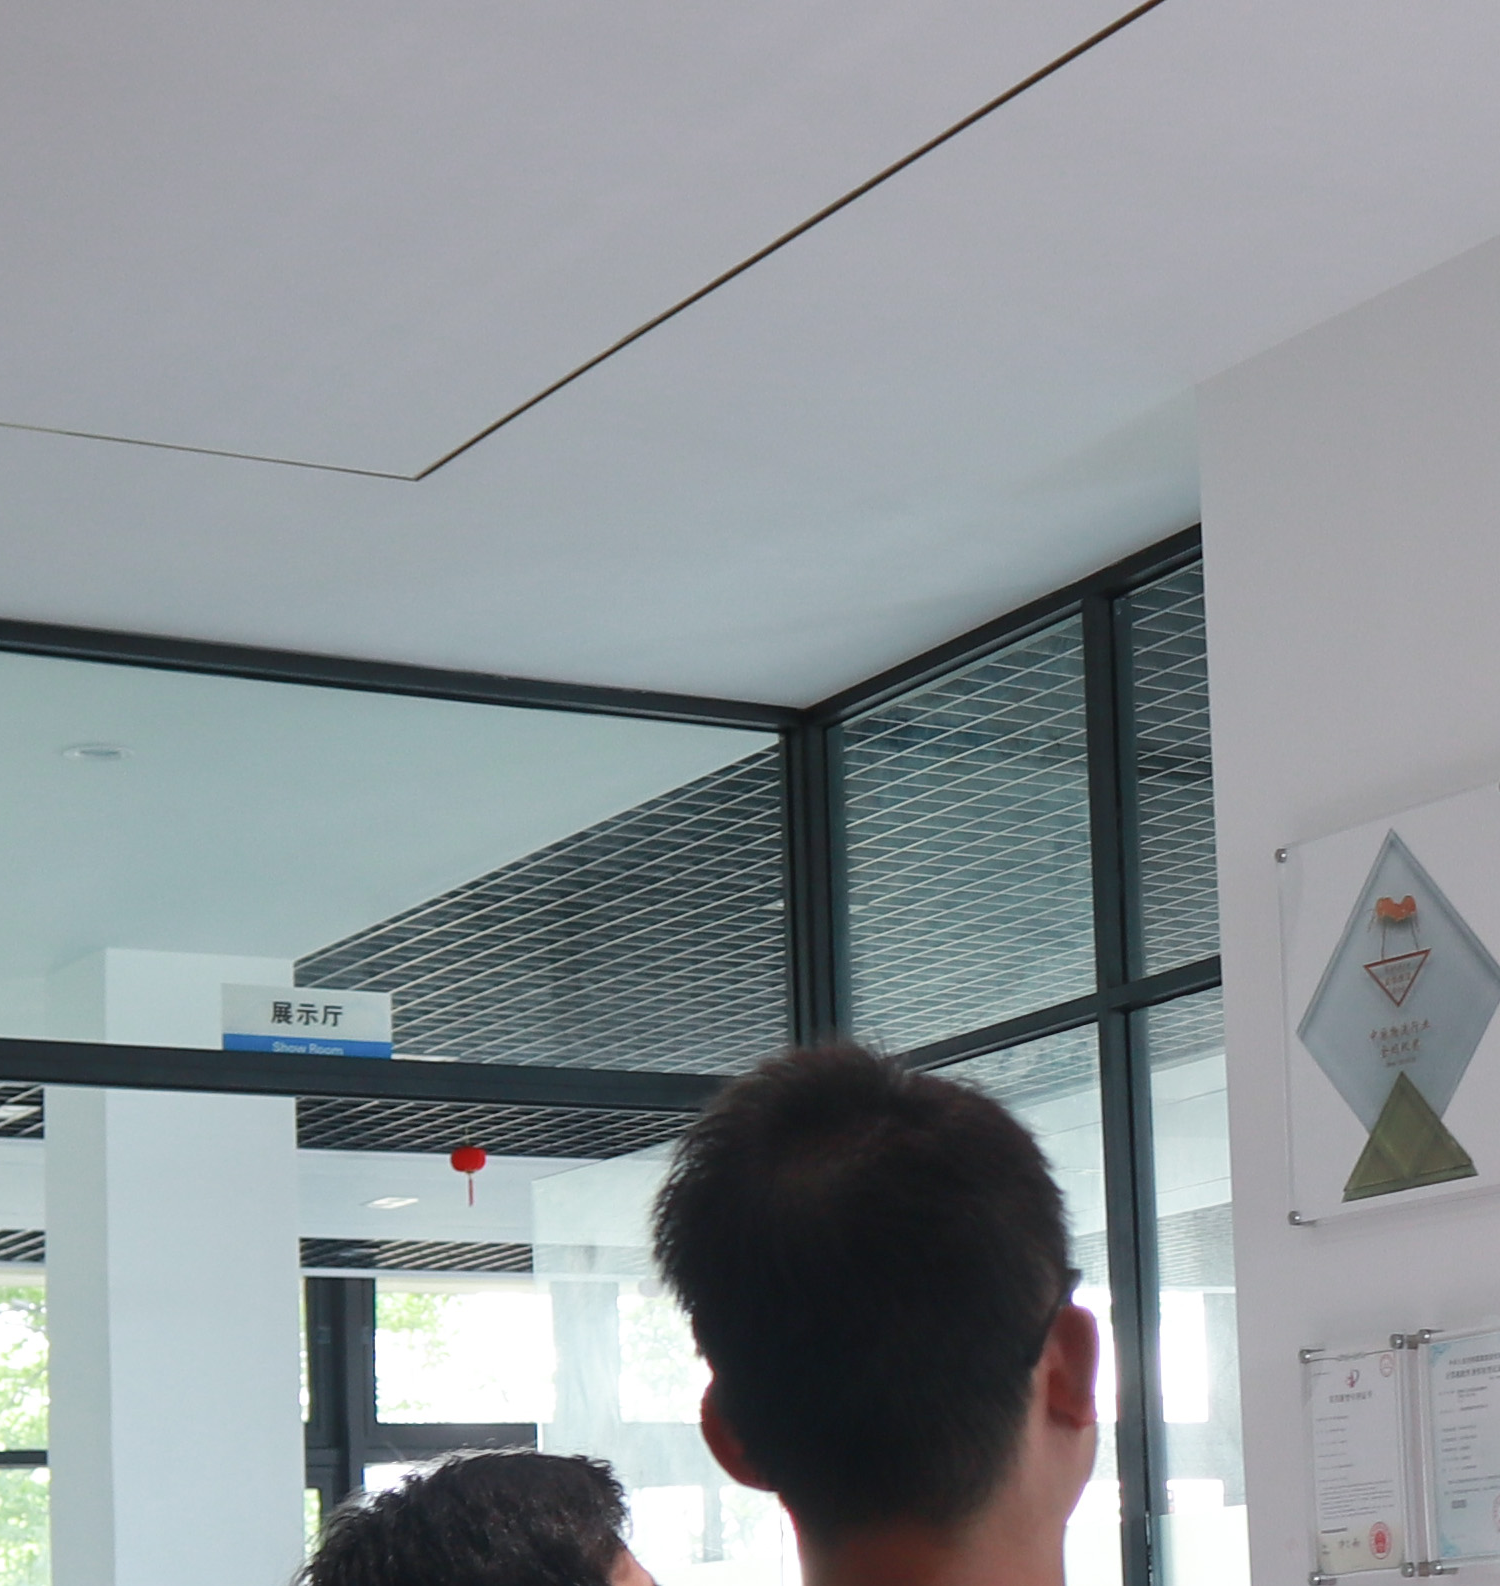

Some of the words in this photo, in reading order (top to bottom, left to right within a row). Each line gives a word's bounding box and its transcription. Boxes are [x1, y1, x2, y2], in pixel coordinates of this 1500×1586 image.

[271, 1000, 344, 1027] 展示厅
[272, 1040, 308, 1054] Show
[309, 1042, 344, 1056] Room
